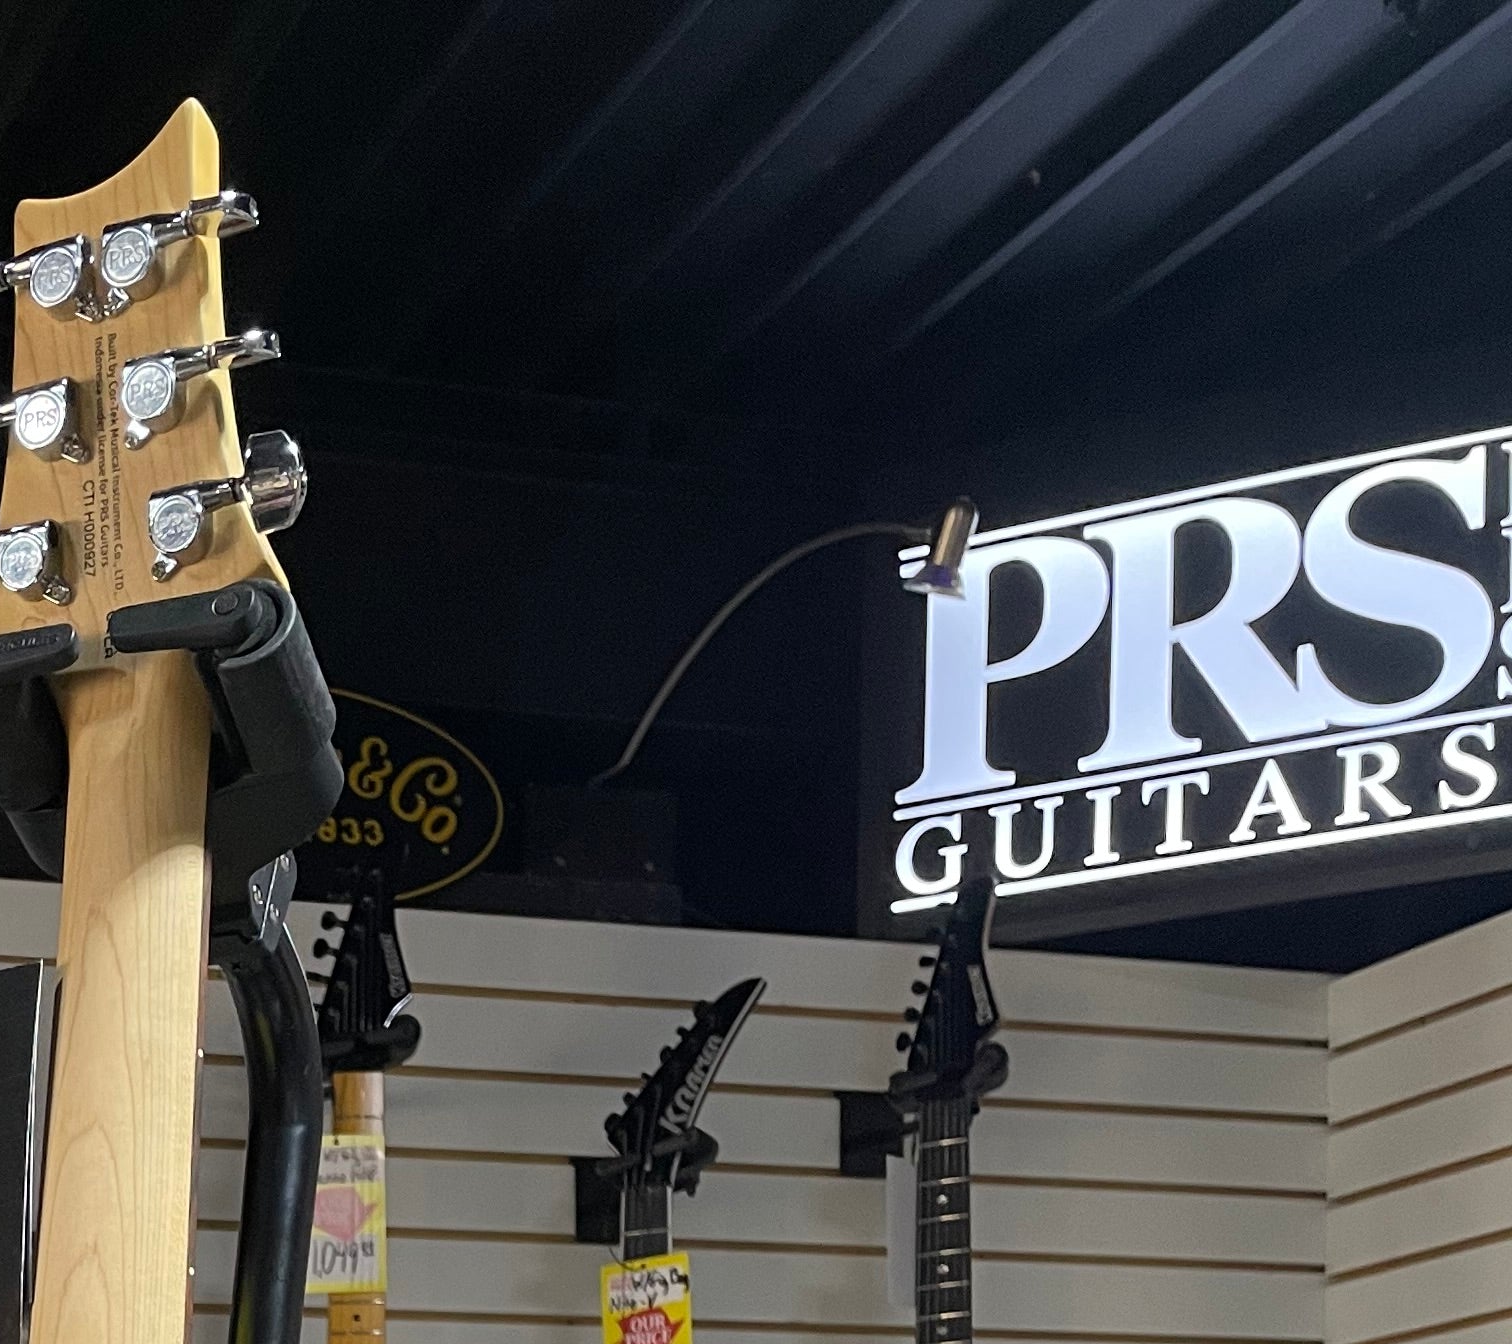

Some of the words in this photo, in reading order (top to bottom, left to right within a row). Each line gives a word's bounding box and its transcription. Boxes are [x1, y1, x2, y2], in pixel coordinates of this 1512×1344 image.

[109, 244, 146, 270] PRS
[107, 332, 117, 361] Built
[107, 363, 118, 378] by
[131, 379, 167, 403] PRS
[23, 407, 58, 429] PRS
[98, 434, 107, 477] license
[110, 428, 120, 473] Musical
[99, 478, 108, 495] for
[100, 498, 109, 522] PRS
[112, 475, 121, 541] Instrument
[100, 524, 110, 568] Guitars
[894, 444, 1494, 806] PRS
[894, 722, 1499, 896] GUITARS
[317, 816, 384, 846] 833
[630, 1312, 666, 1333] OUR
